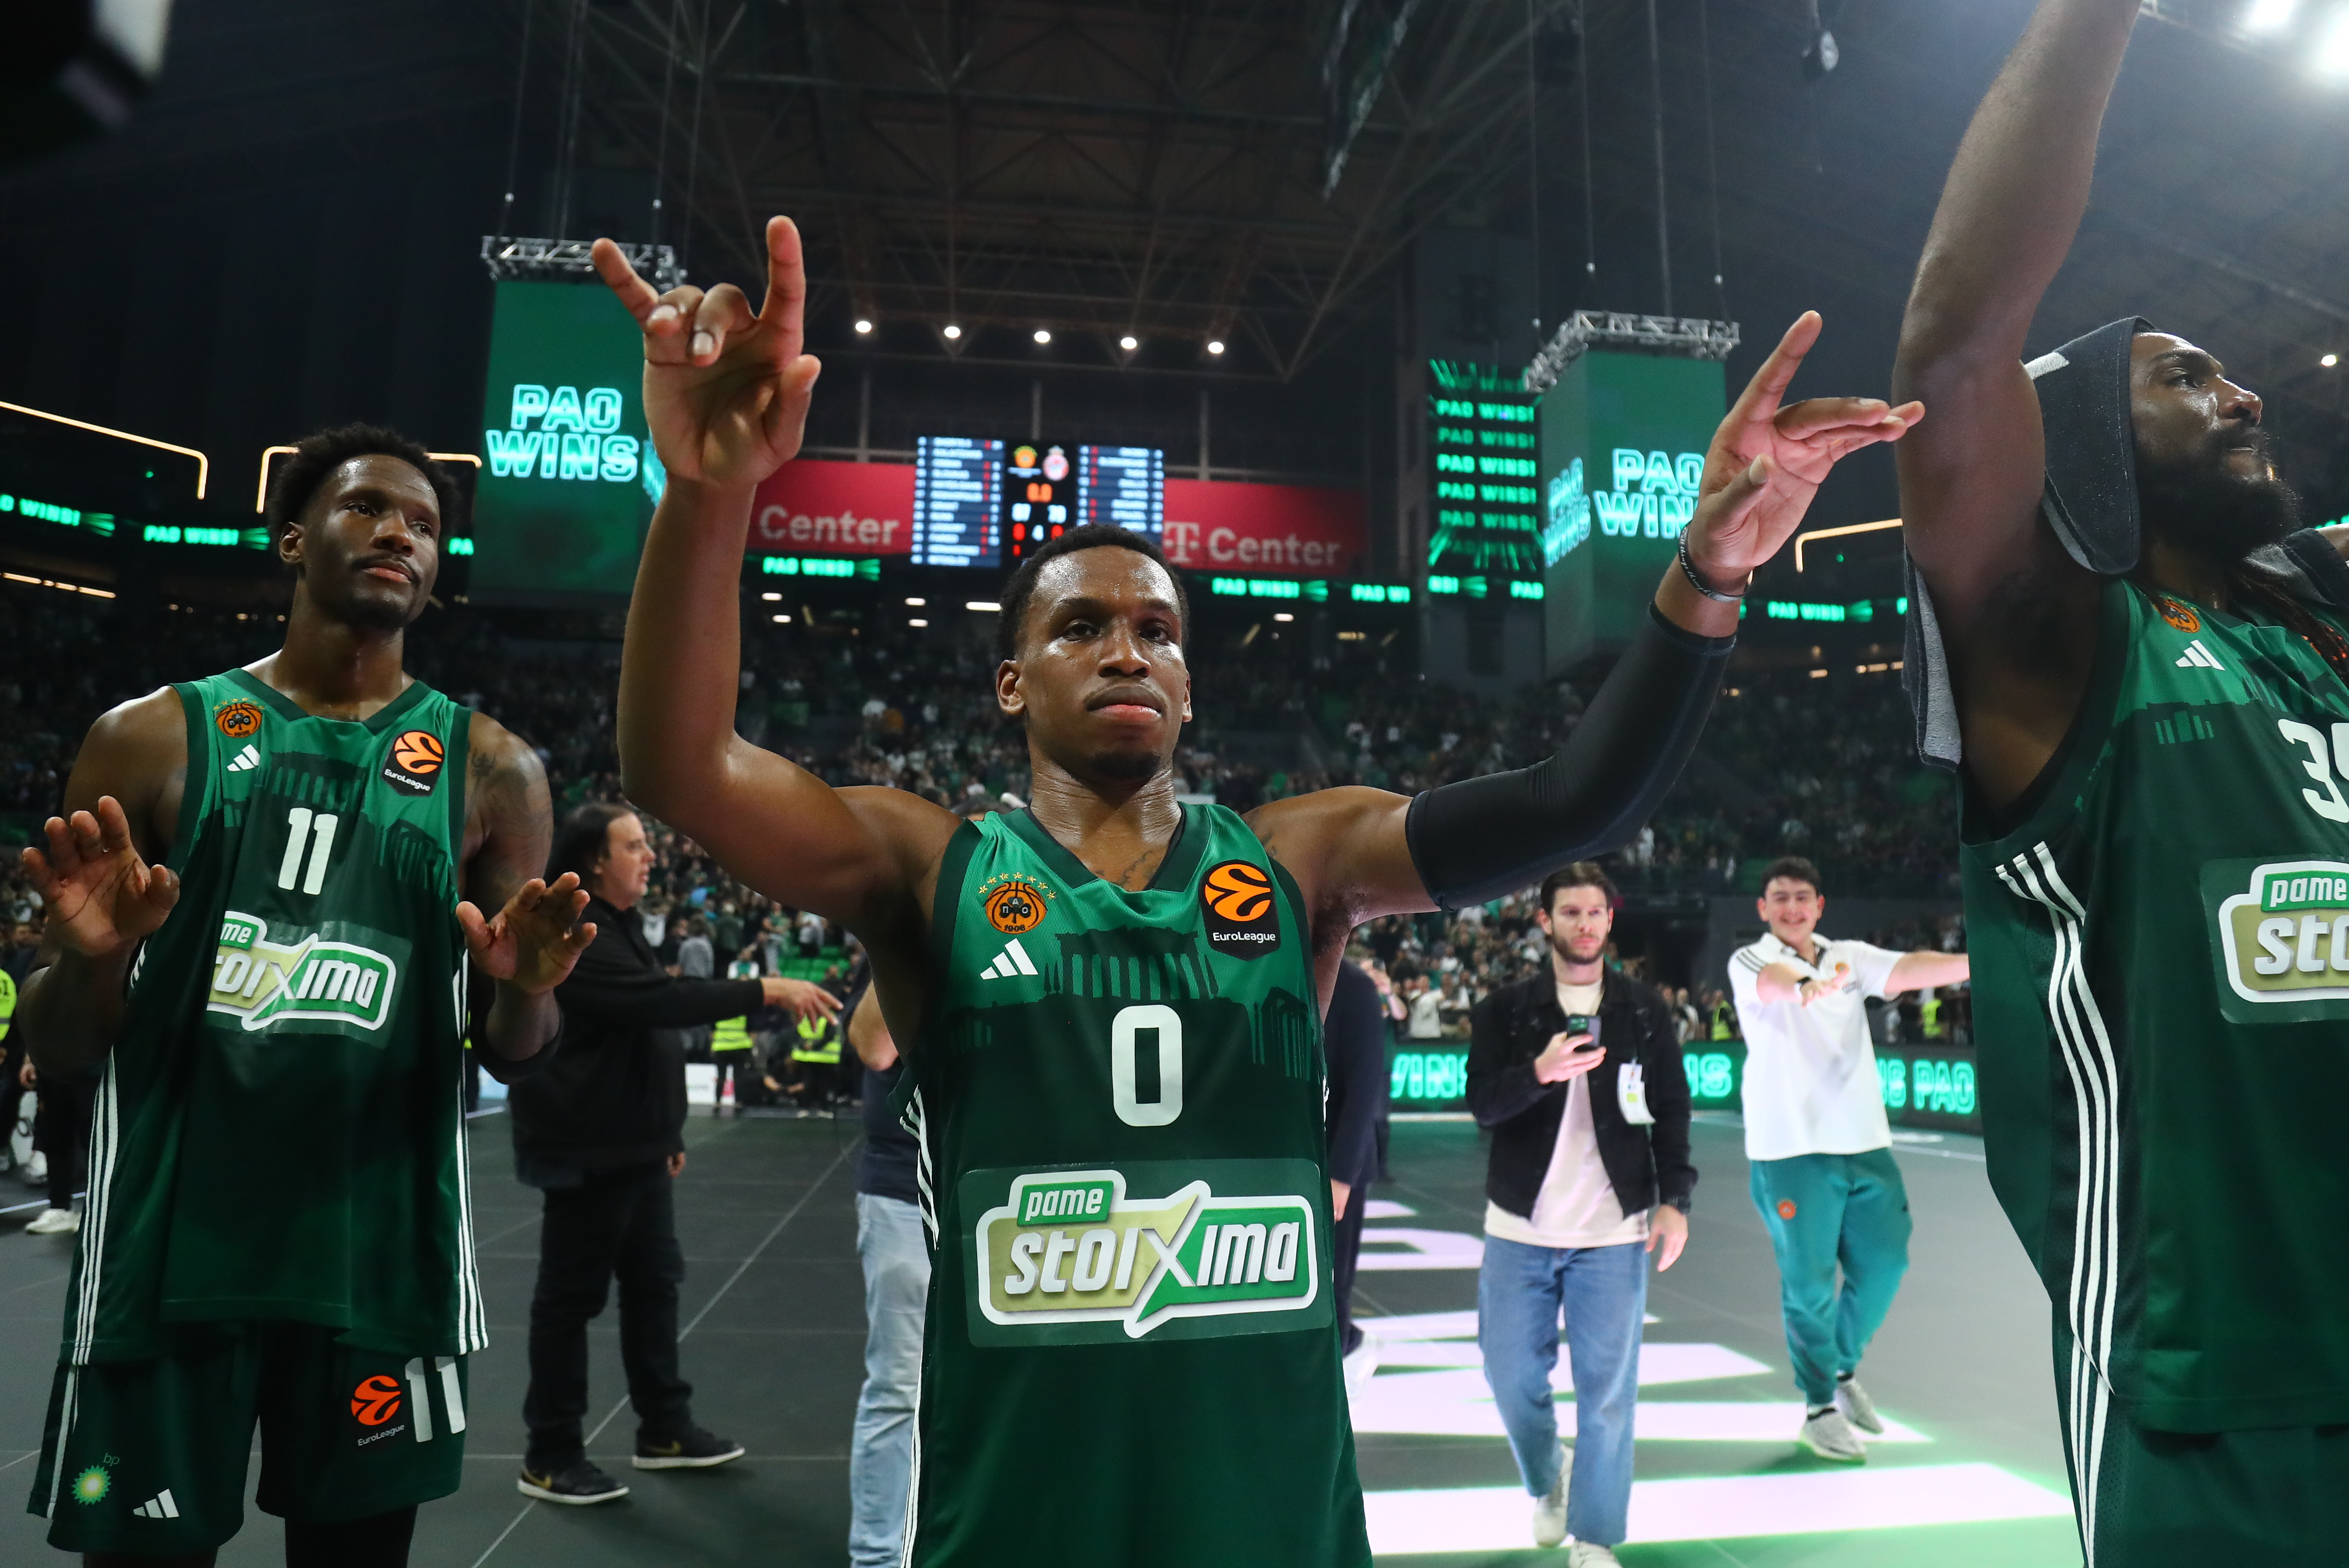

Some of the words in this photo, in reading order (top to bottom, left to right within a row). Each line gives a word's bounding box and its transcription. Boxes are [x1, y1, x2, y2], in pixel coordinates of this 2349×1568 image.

[510, 384, 622, 434] PAO
[1437, 400, 1474, 418] PAO
[1437, 427, 1474, 445] PAO
[486, 429, 639, 482] WINS
[1437, 453, 1475, 473] PAO
[1612, 448, 1705, 497] PAO
[1437, 481, 1475, 500] PAO
[759, 505, 900, 546] Center
[1439, 510, 1475, 527] PAO
[1593, 490, 1696, 539] WIN
[144, 525, 181, 543] PAO
[449, 537, 473, 555] PA
[1209, 527, 1341, 566] Center
[763, 557, 799, 575] PAO
[1680, 546, 1689, 569] things
[1212, 577, 1246, 596] PAO
[1351, 583, 1385, 602] PAO
[1767, 601, 1798, 620] PAO
[384, 769, 430, 791] EuroLeague
[277, 807, 338, 895] 11
[2269, 877, 2347, 907] pame
[220, 923, 253, 943] me
[1212, 932, 1276, 943] EuroLeague
[1112, 1004, 1183, 1126] 0
[1913, 1059, 1975, 1114] PAO
[1025, 1187, 1103, 1222] pame
[405, 1356, 466, 1442] 11
[357, 1424, 405, 1446] EuroLeague
[103, 1452, 120, 1466] bp
